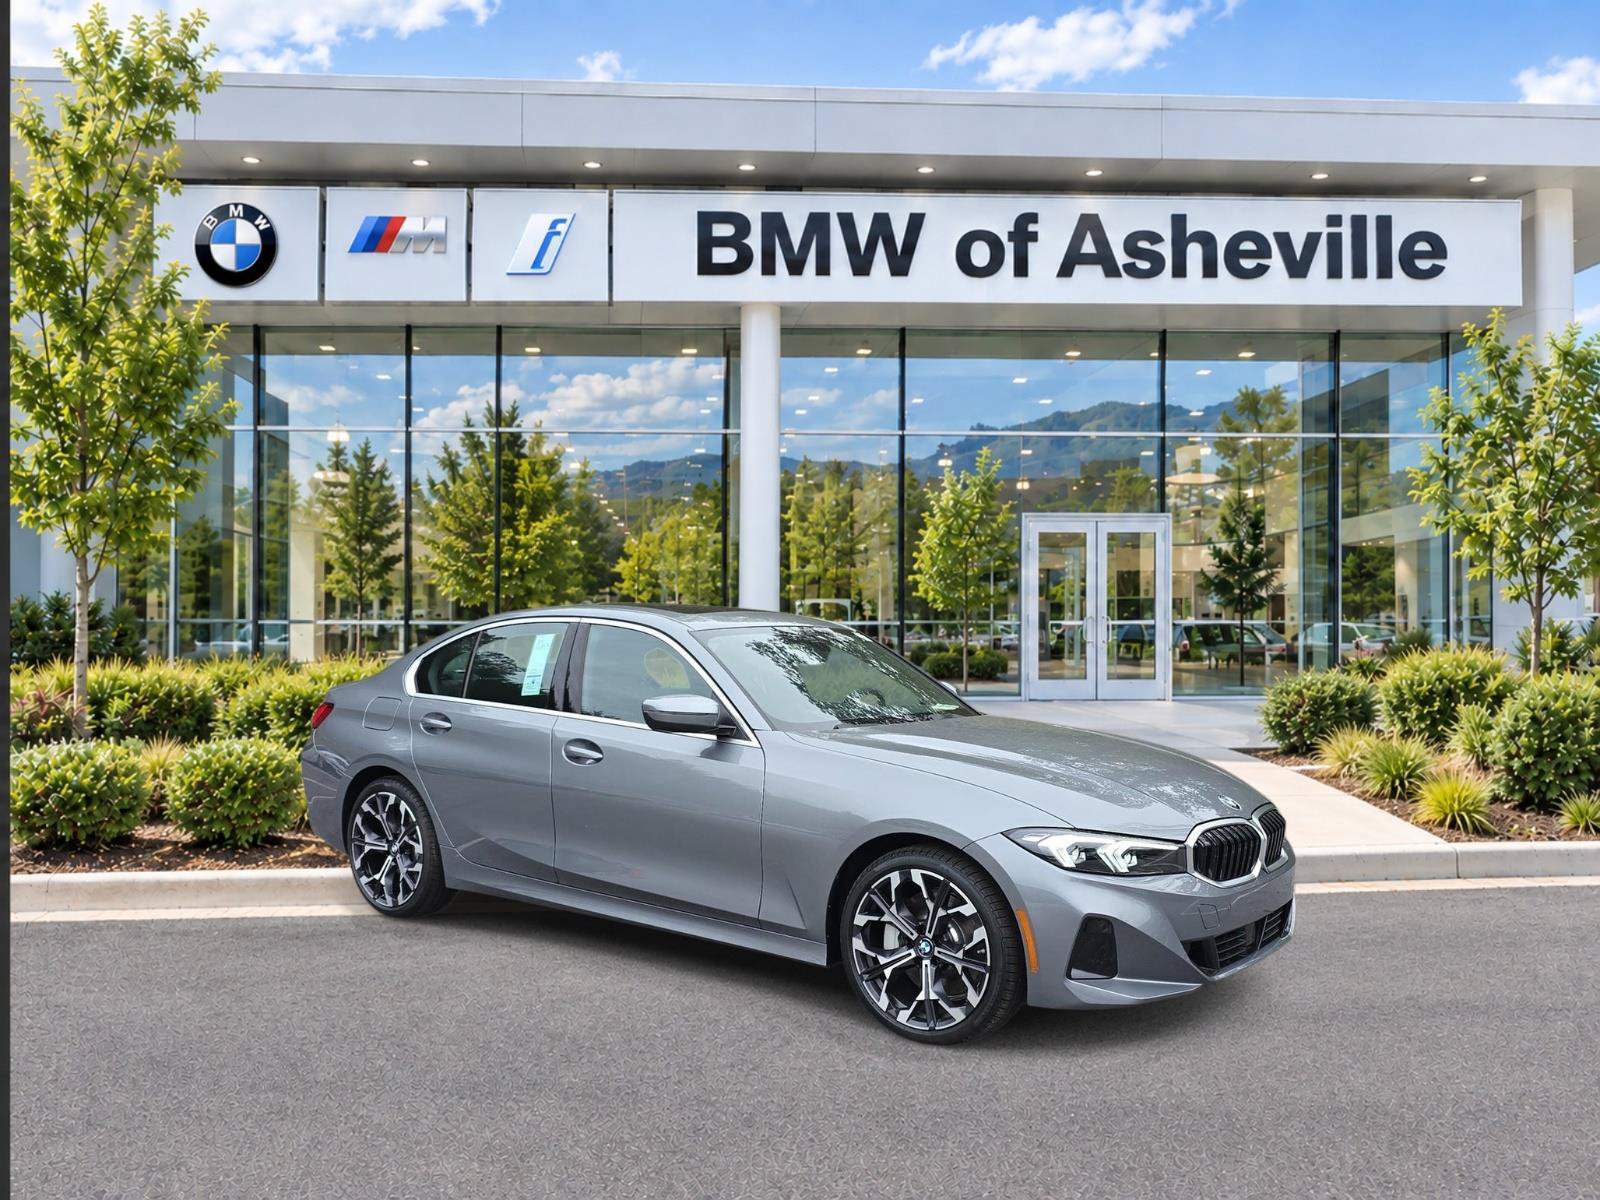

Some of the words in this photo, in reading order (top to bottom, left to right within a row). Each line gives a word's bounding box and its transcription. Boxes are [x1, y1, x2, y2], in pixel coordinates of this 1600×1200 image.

[202, 204, 271, 231] BMW
[389, 216, 447, 254] M
[697, 210, 926, 277] BMW
[955, 212, 1039, 279] of
[1056, 213, 1448, 280] Asheville
